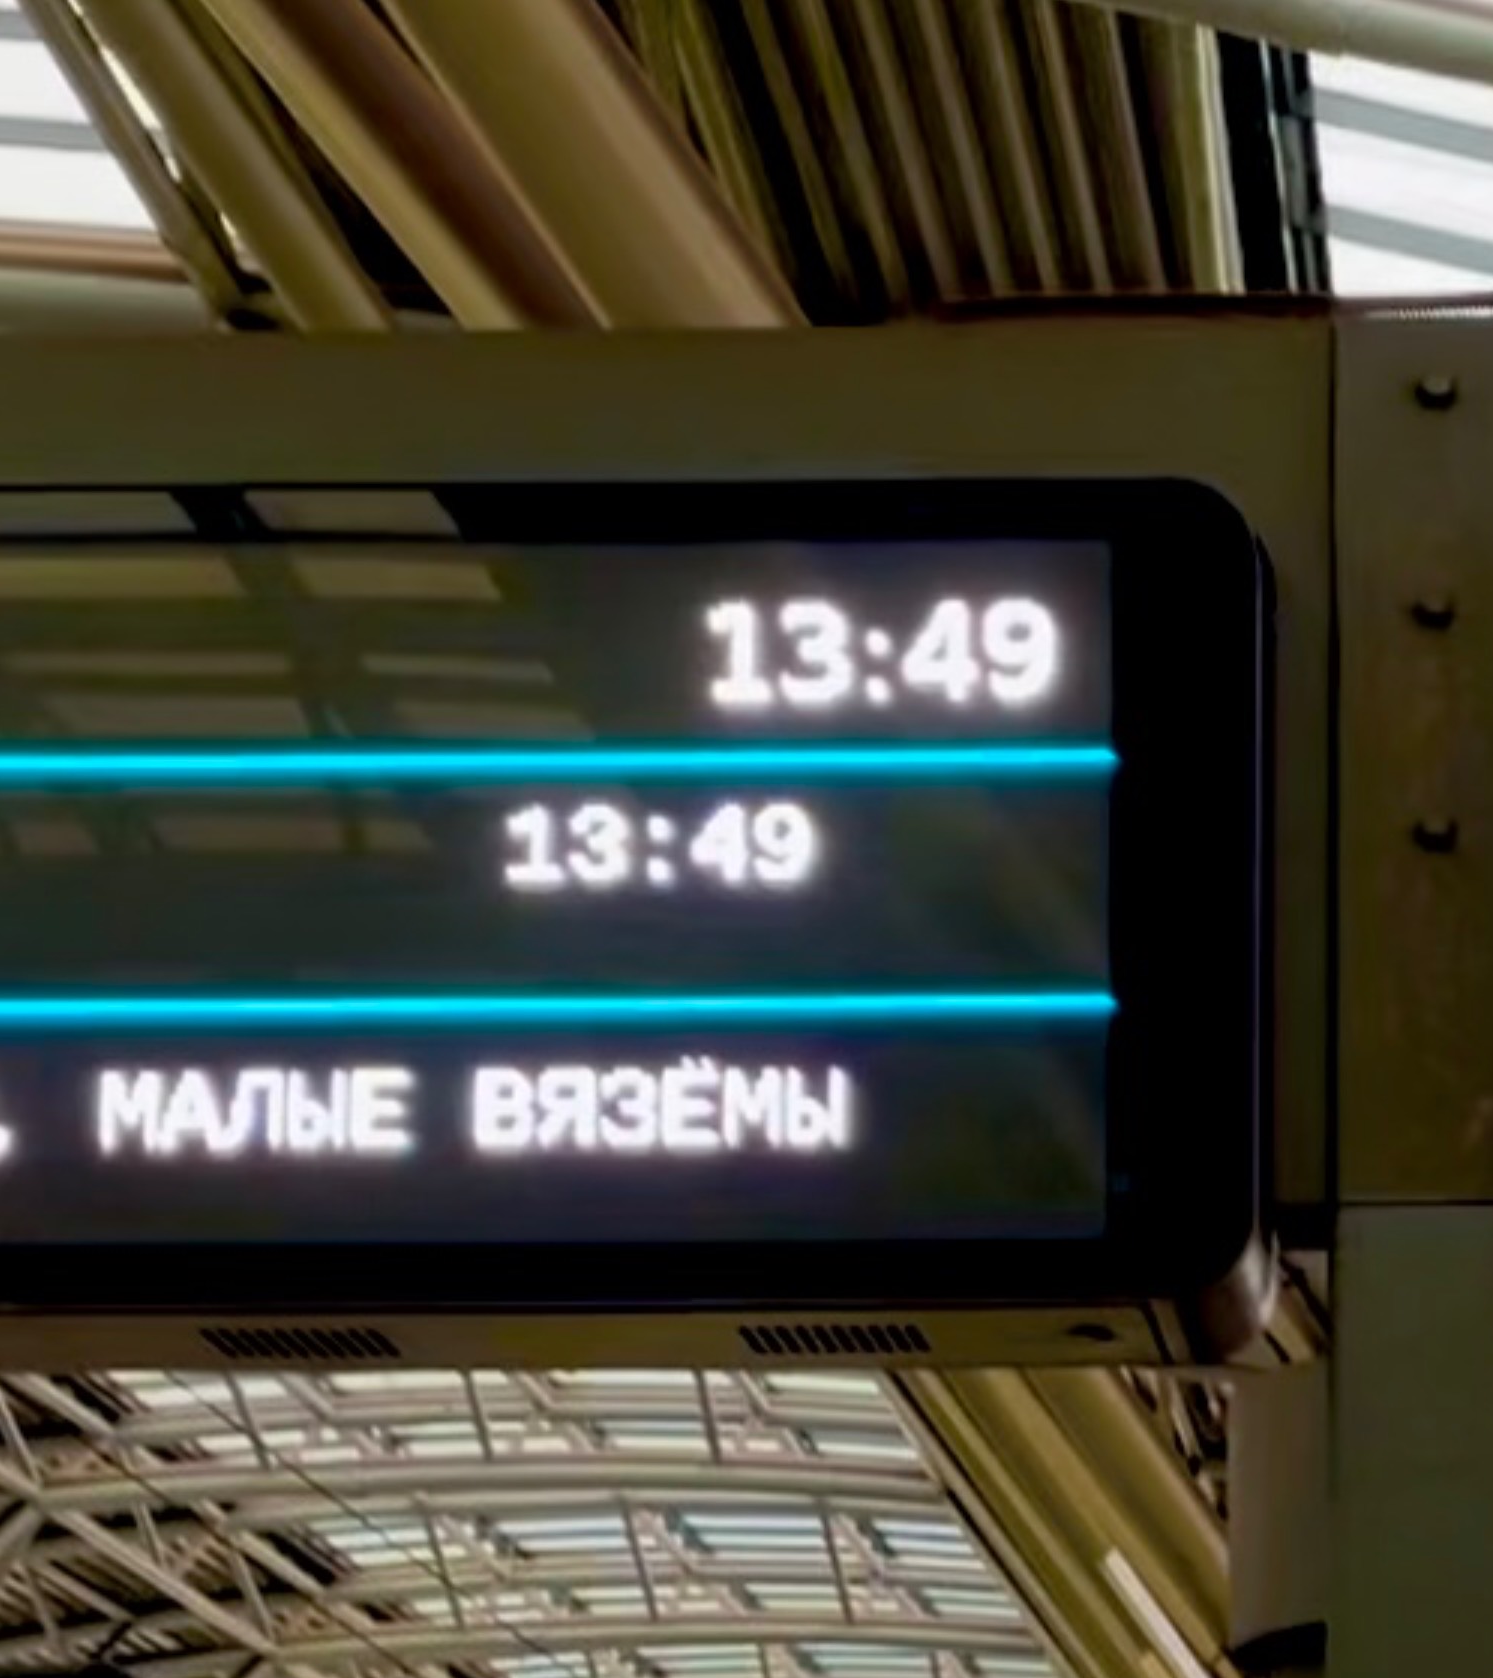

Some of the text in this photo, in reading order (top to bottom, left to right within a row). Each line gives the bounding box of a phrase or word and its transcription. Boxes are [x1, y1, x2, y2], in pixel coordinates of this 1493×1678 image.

[705, 597, 1061, 711] 13:49
[504, 801, 819, 888] 13:49
[96, 1066, 414, 1155] МАЛЫЕ
[470, 1055, 850, 1153] ВЯЗЁМЫ
